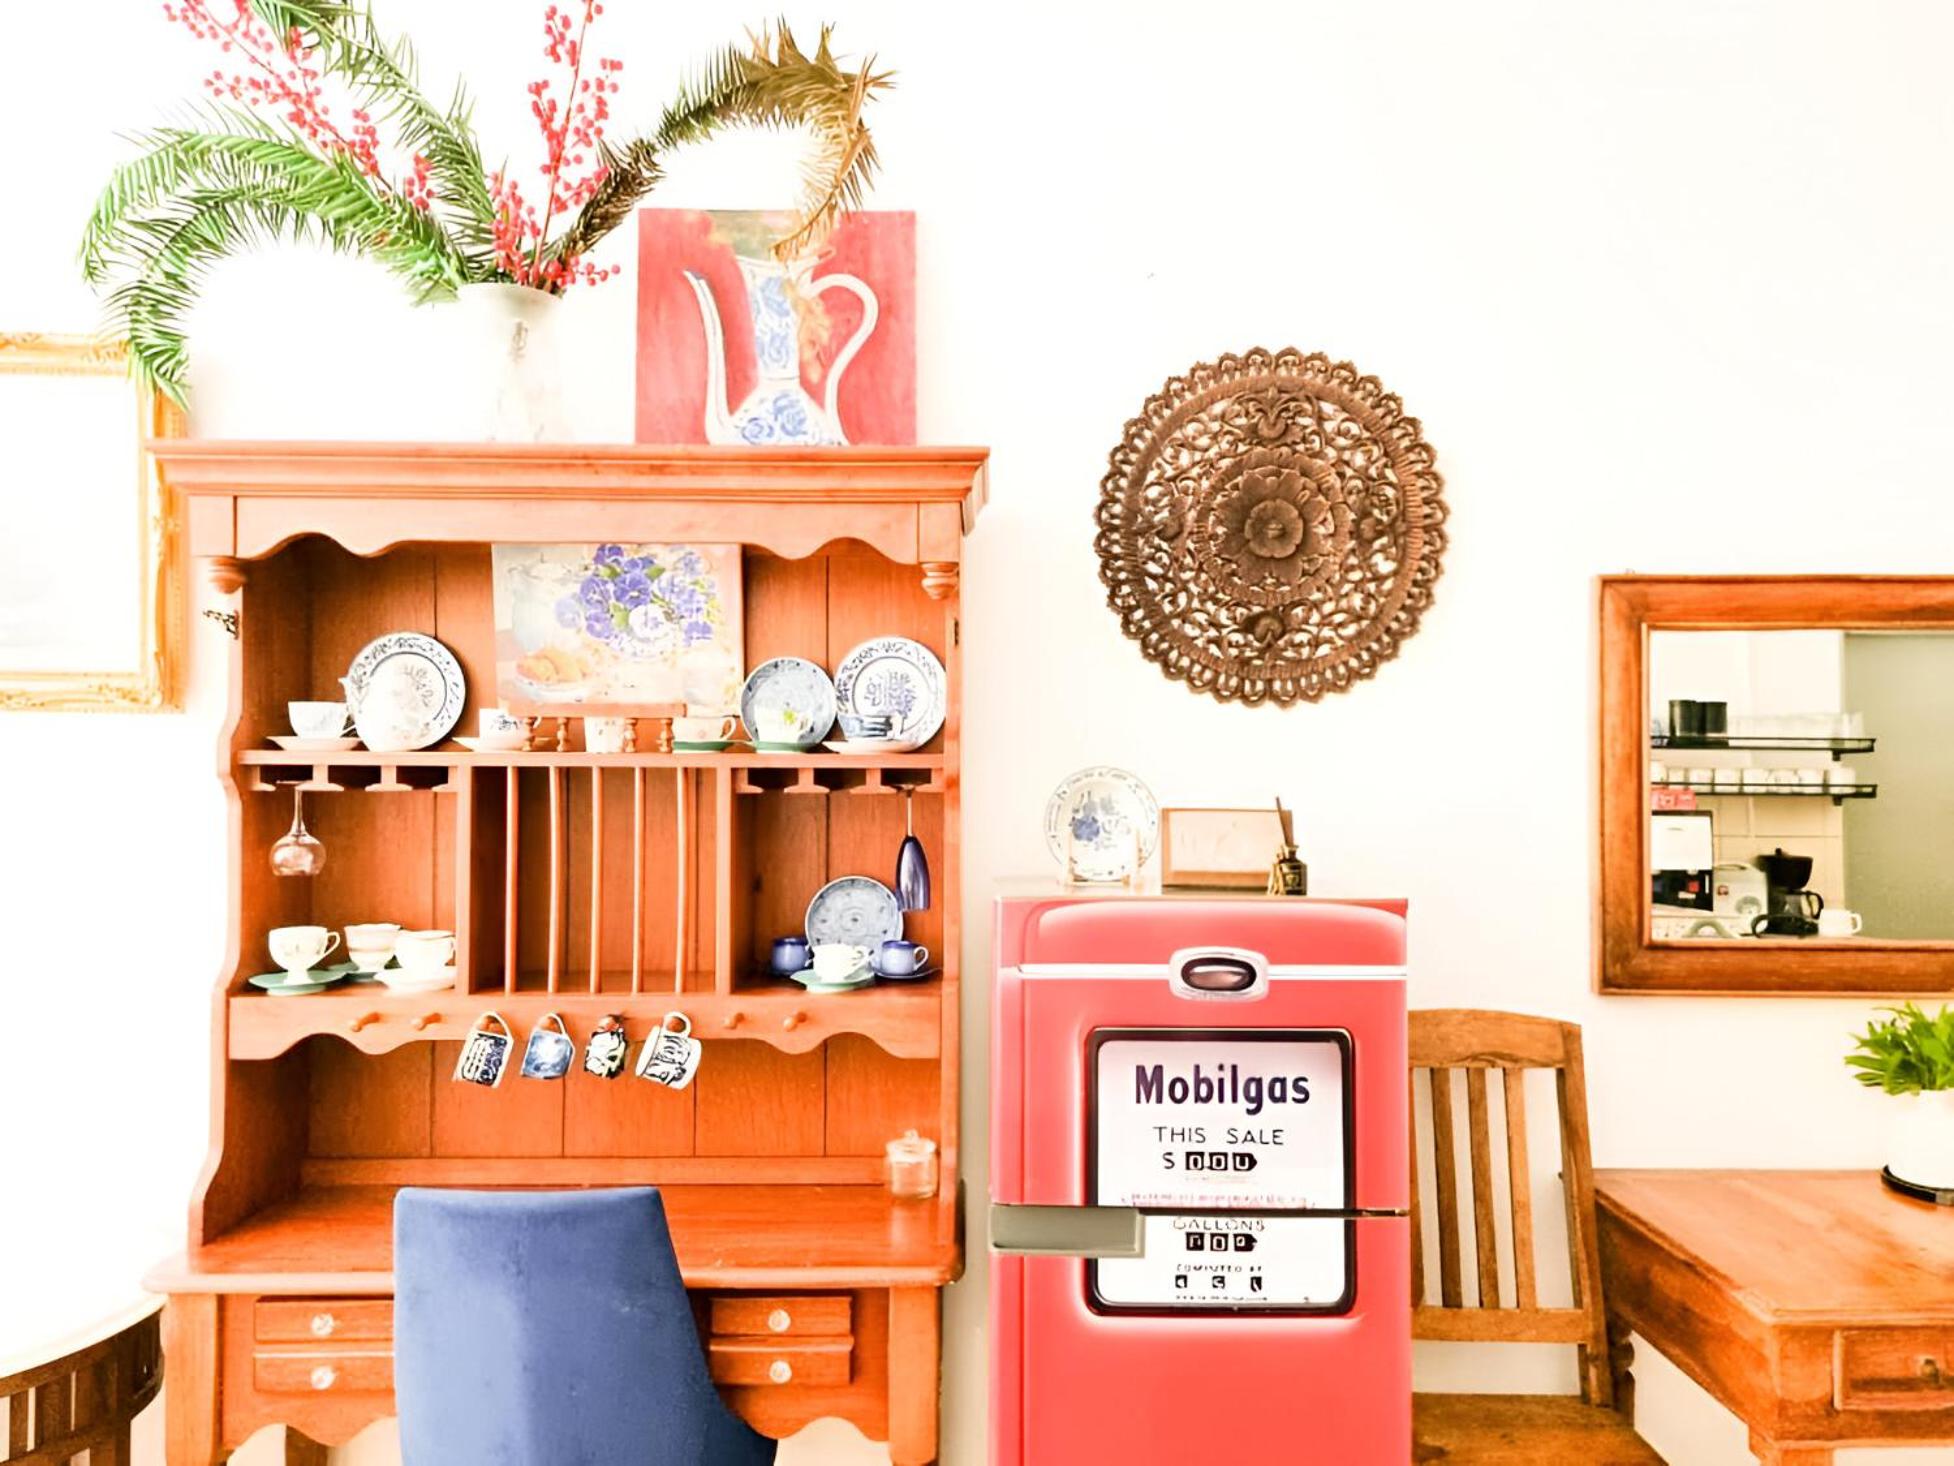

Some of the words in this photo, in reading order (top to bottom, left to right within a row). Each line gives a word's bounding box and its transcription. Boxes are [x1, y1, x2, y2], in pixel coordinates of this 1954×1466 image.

[1135, 1063, 1310, 1116] Mobilgas
[1152, 1126, 1206, 1144] THIS
[1226, 1128, 1284, 1145] SALE
